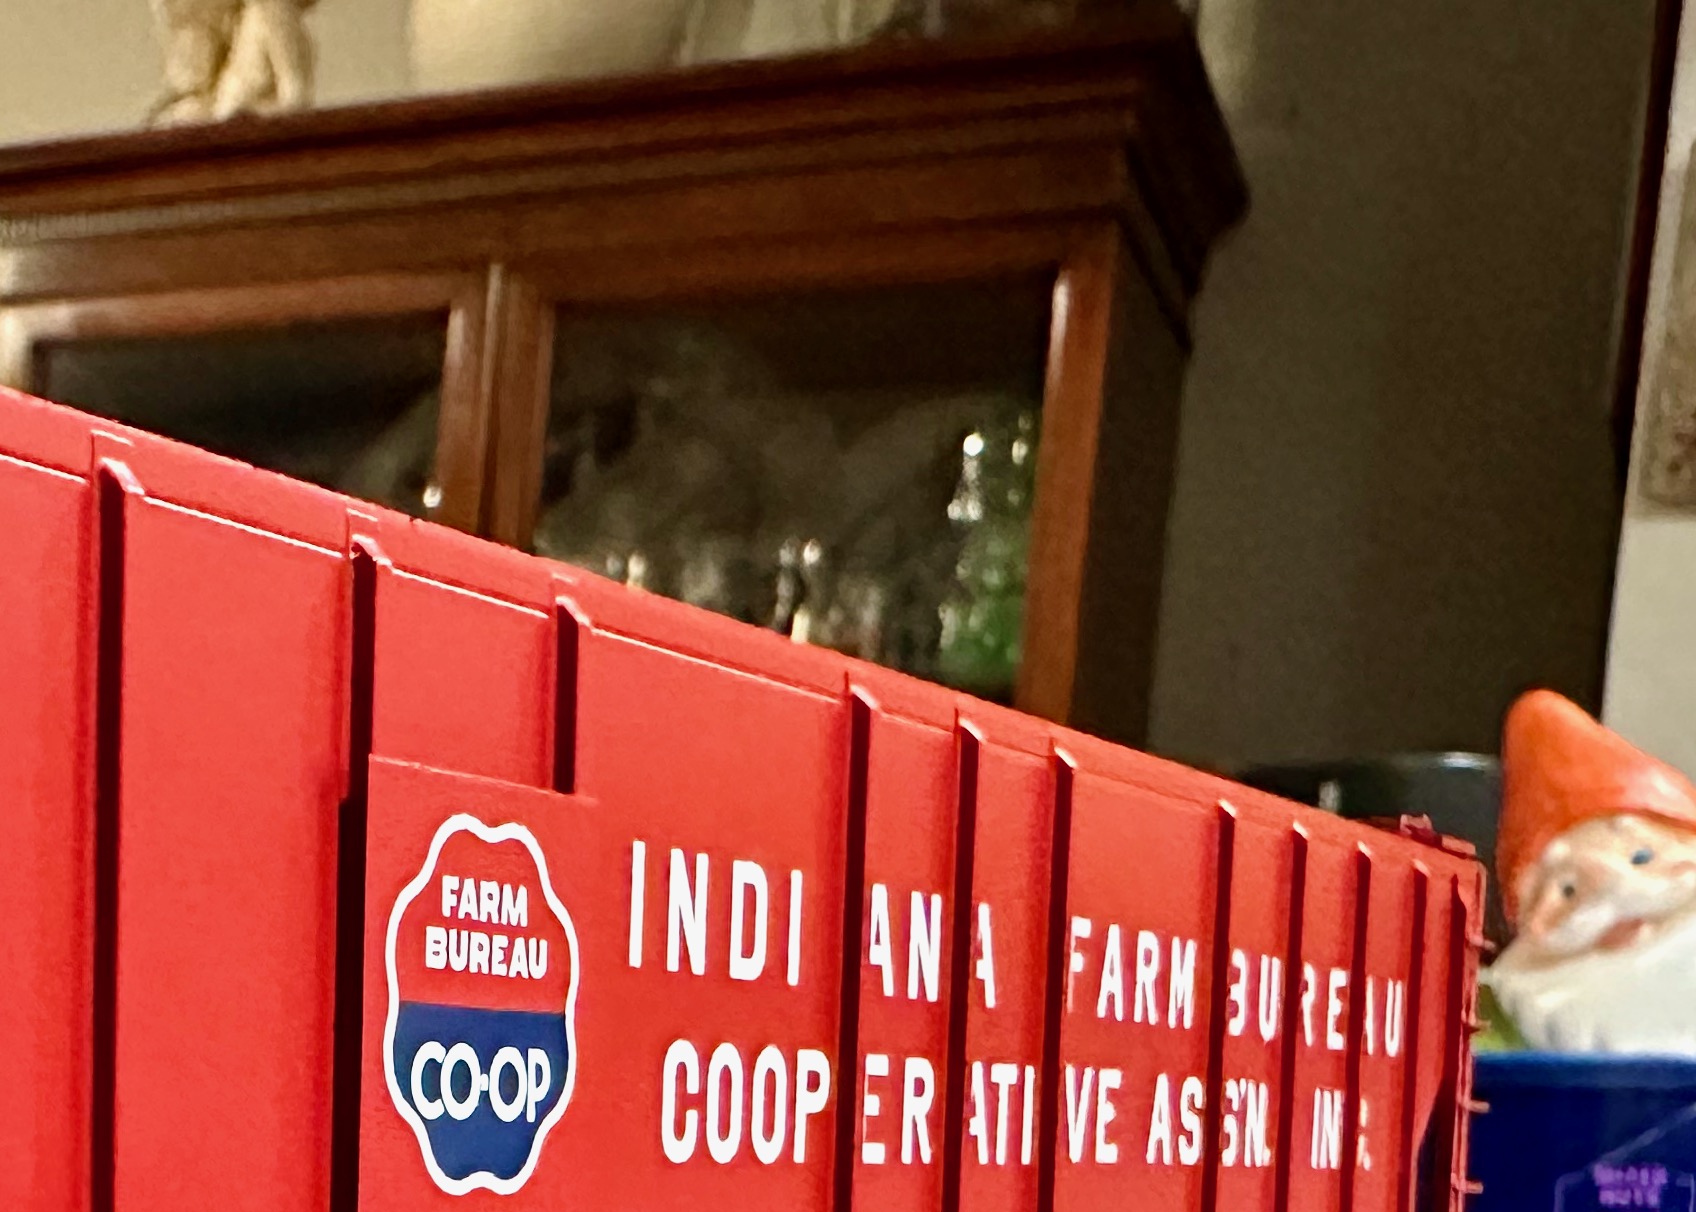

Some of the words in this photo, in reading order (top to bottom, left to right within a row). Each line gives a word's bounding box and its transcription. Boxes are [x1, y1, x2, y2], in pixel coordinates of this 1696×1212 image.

[442, 874, 528, 927] FARM
[628, 840, 997, 1009] INDIANA
[1067, 915, 1197, 1030] FARM
[425, 926, 549, 980] BUREAU
[411, 1041, 552, 1123] CO-OP
[661, 1038, 1123, 1166] COOPERATIVE
